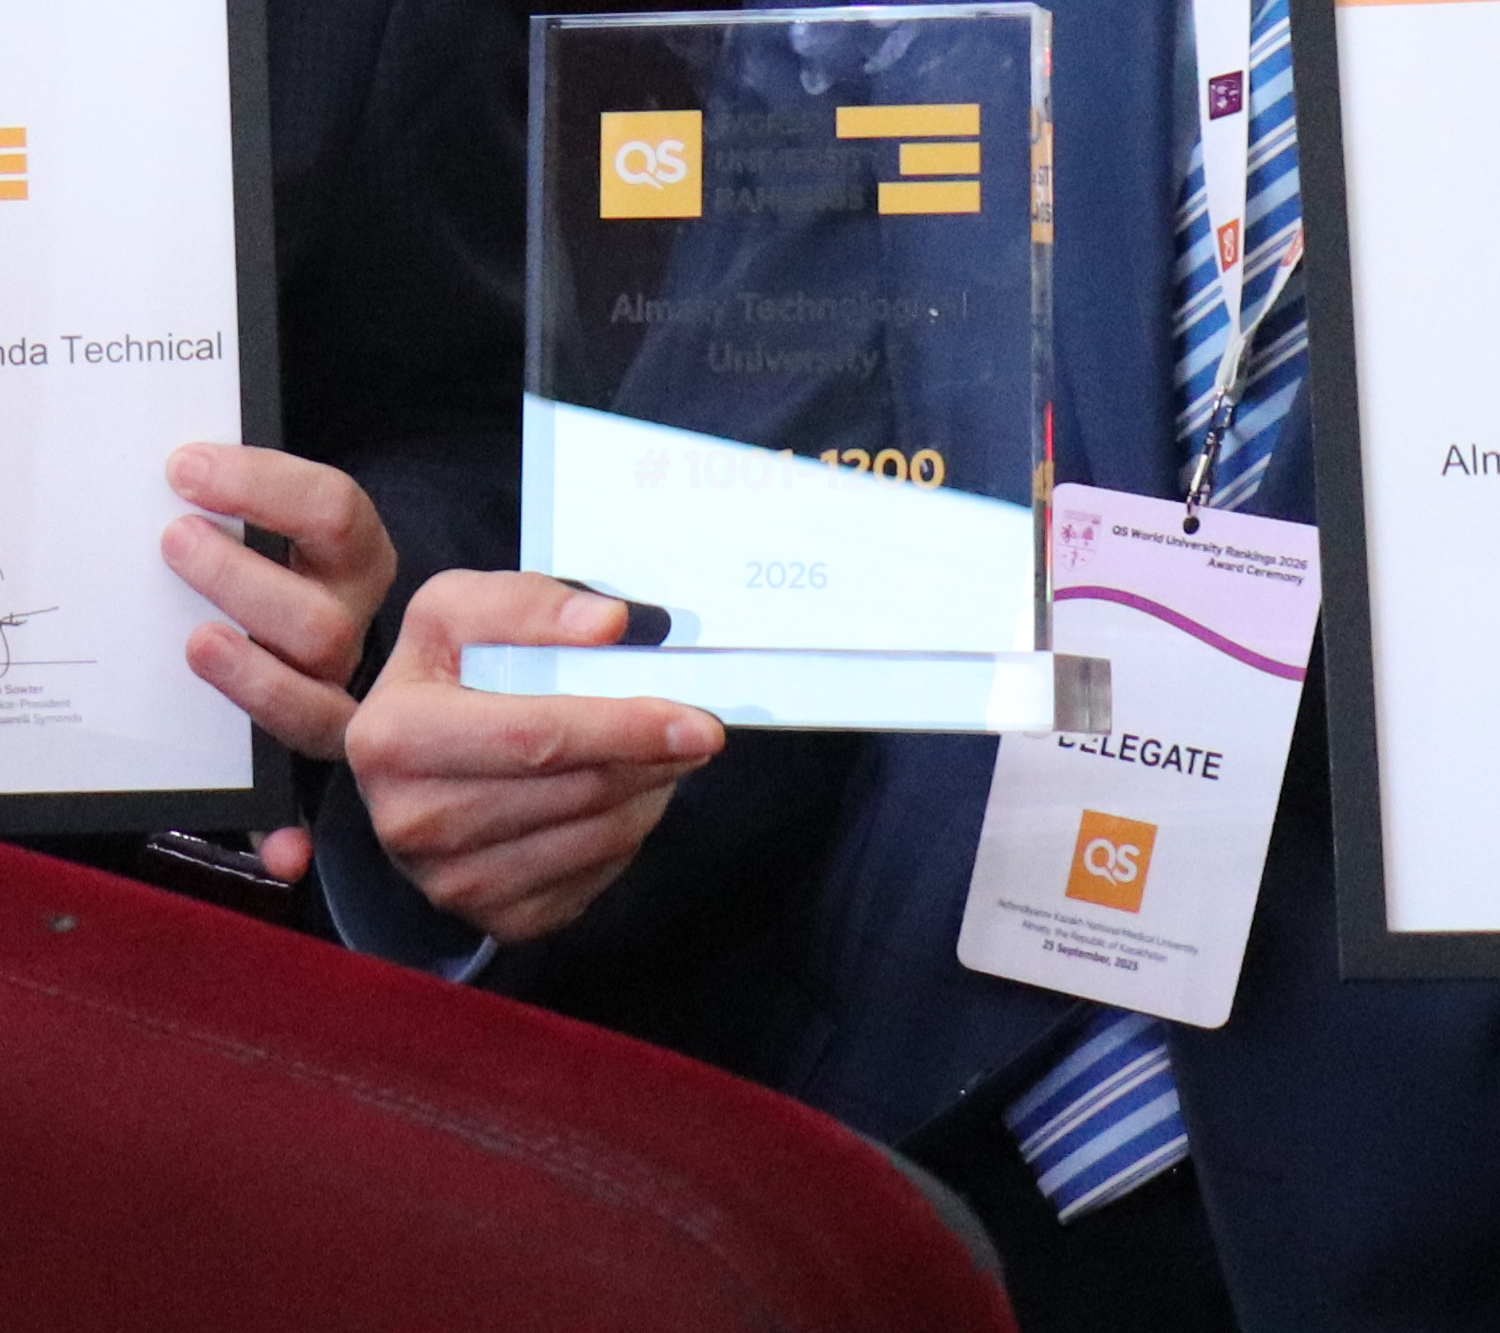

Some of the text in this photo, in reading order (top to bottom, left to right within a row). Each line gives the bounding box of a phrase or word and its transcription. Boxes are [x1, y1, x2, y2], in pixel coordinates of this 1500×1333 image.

[614, 139, 688, 190] QS
[60, 331, 222, 364] Technical
[687, 448, 946, 490] 1001-1200
[1131, 528, 1164, 544] World
[1166, 535, 1223, 556] University
[1226, 546, 1276, 565] Rankings
[1278, 555, 1308, 570] 2026
[745, 561, 829, 590] 2026
[1207, 558, 1304, 586] Award Ceremony
[1083, 838, 1141, 886] QS
